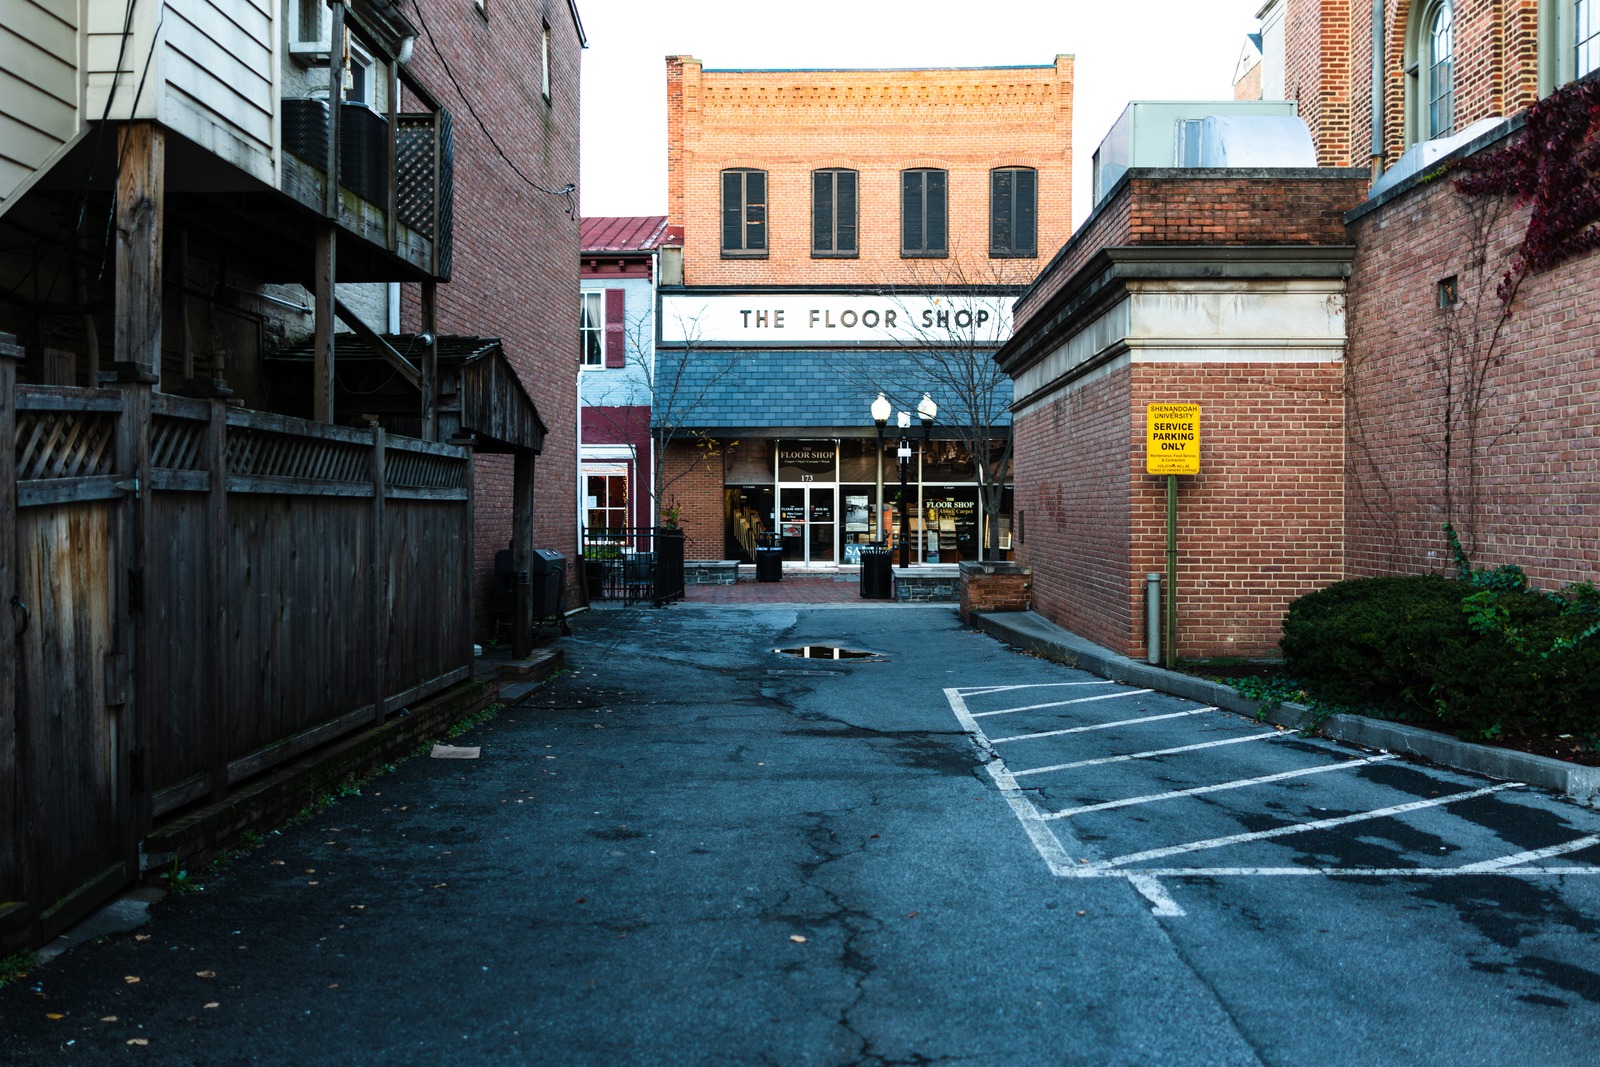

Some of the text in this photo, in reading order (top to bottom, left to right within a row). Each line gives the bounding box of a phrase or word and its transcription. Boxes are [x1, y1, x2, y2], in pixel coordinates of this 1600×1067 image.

[740, 310, 990, 328] THE FLOOR SHOP
